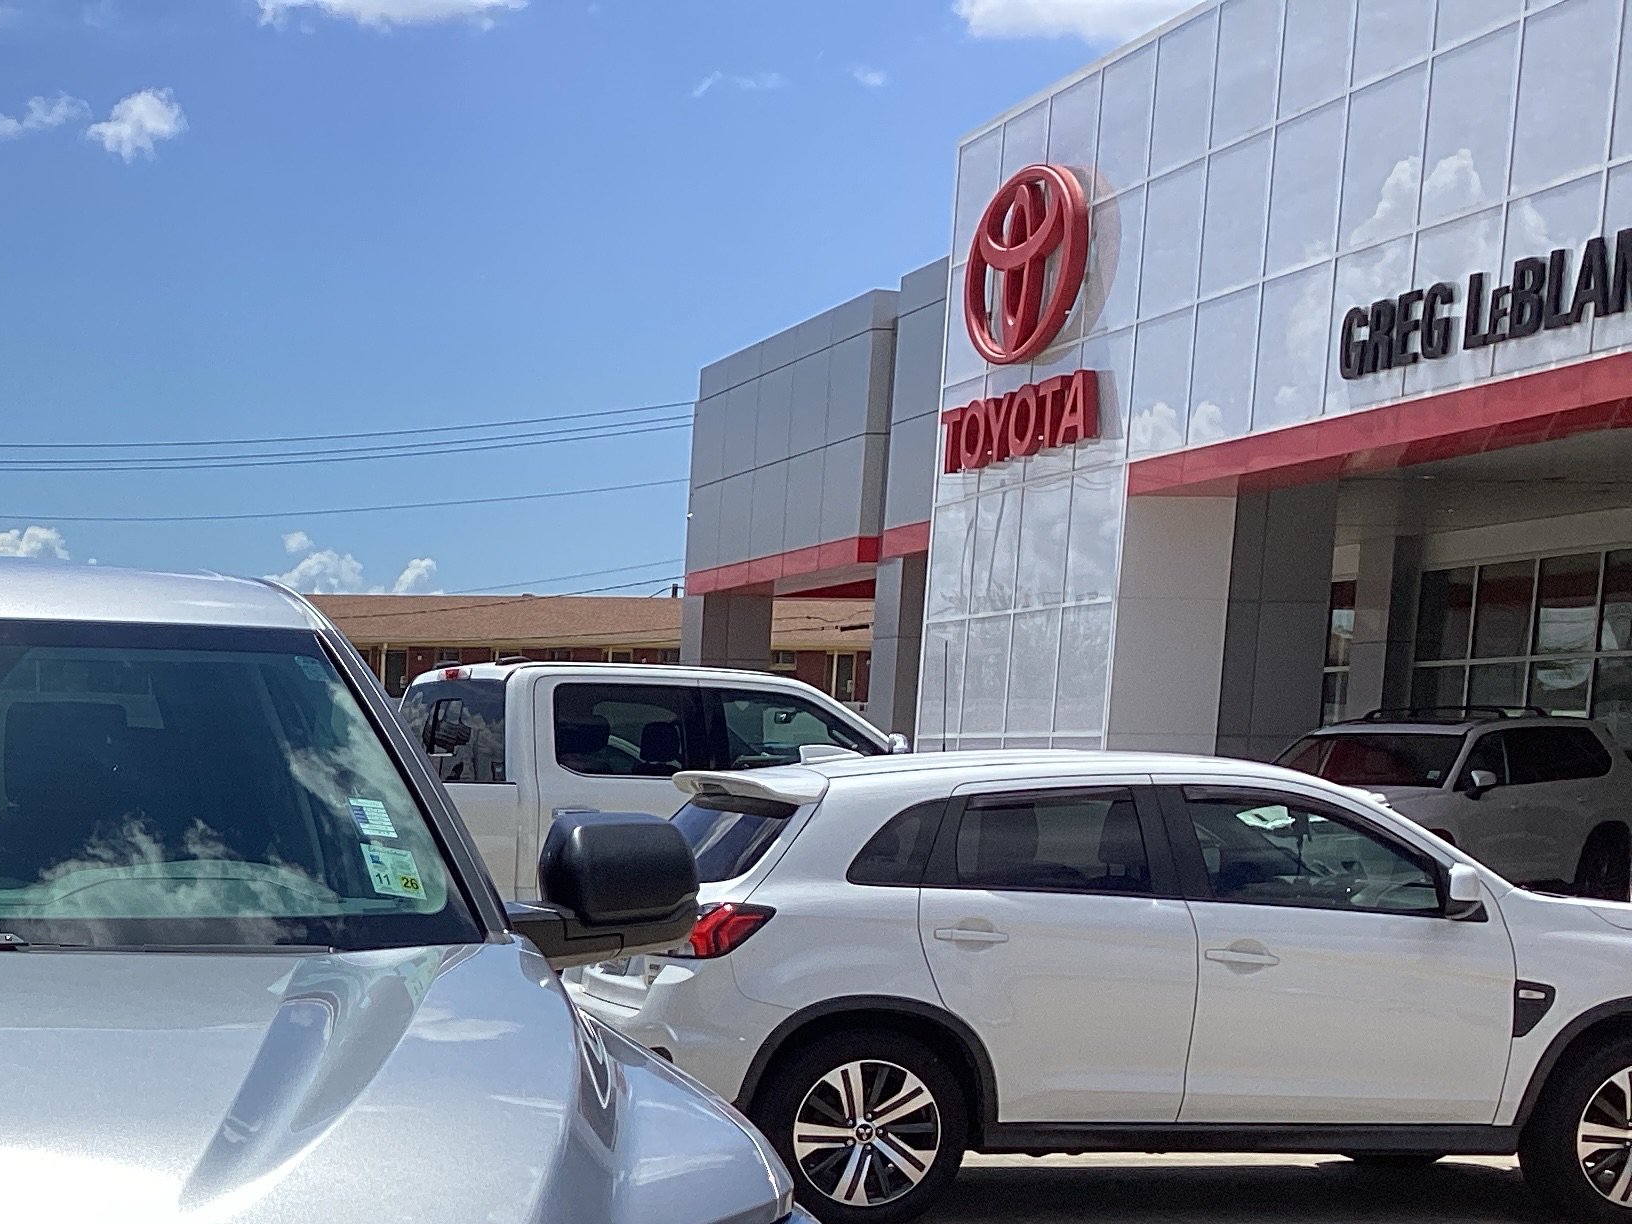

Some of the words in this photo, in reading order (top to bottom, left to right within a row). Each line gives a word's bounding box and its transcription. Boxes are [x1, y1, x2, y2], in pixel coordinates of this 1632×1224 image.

[1339, 283, 1453, 380] GREG
[942, 370, 1098, 475] TOYOTA
[376, 873, 391, 885] 11
[402, 876, 419, 890] 26
